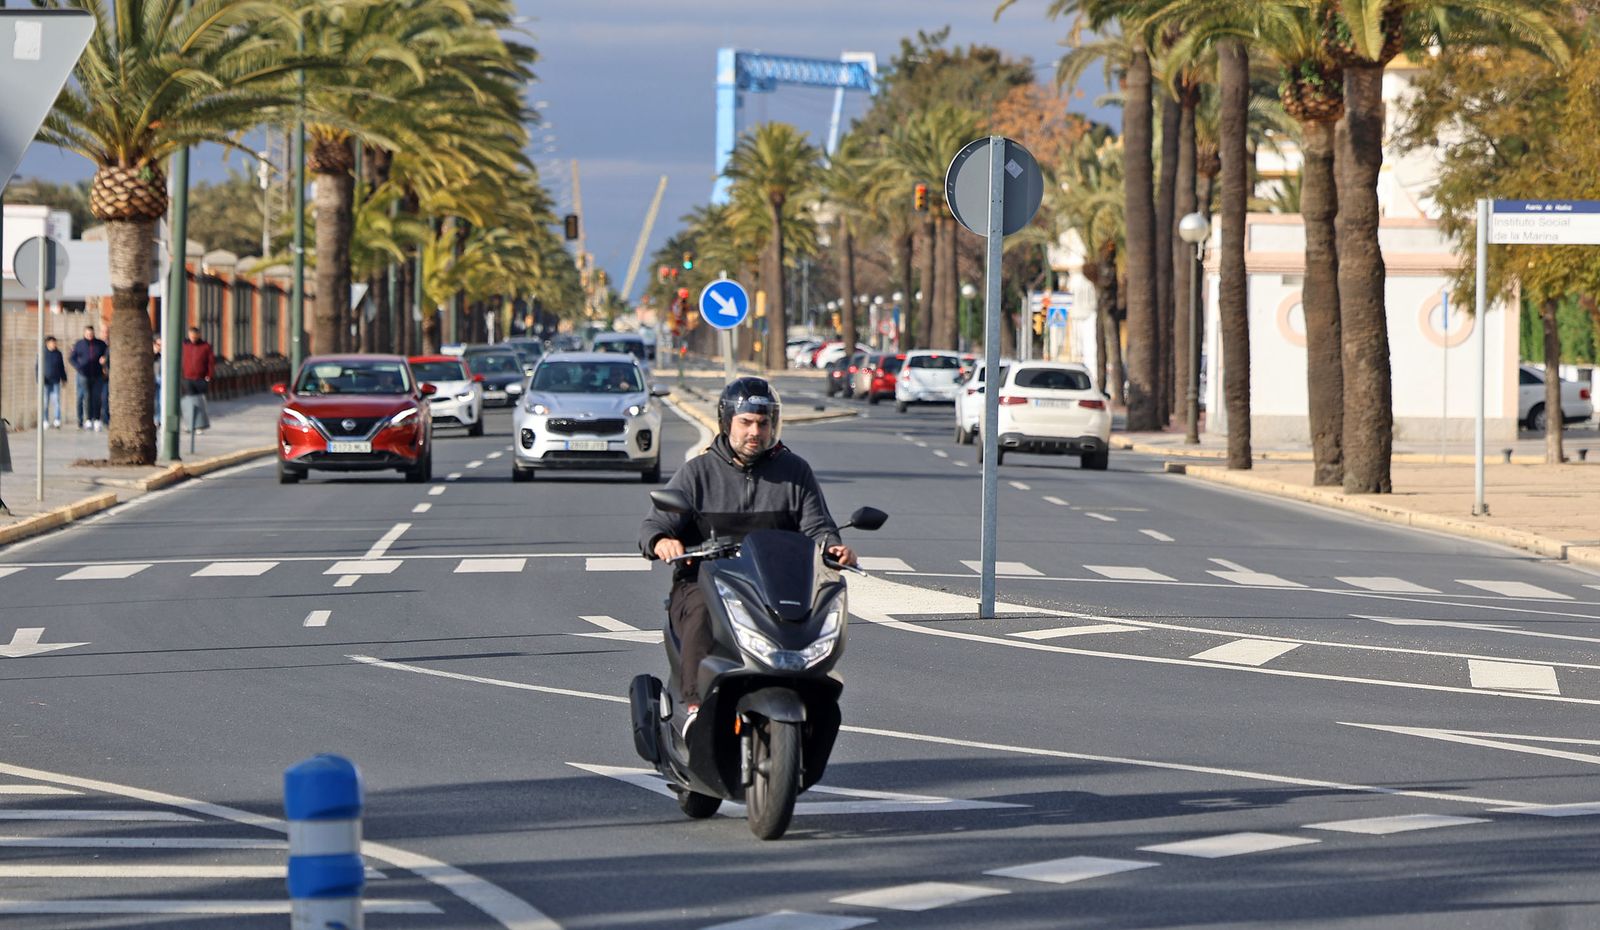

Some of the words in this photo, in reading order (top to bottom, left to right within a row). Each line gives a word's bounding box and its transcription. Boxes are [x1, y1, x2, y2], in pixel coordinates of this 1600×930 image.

[1494, 217, 1536, 226] Instituto
[1538, 216, 1570, 226] Social
[1494, 231, 1507, 240] de
[1510, 231, 1520, 240] la
[1523, 231, 1559, 240] Marina
